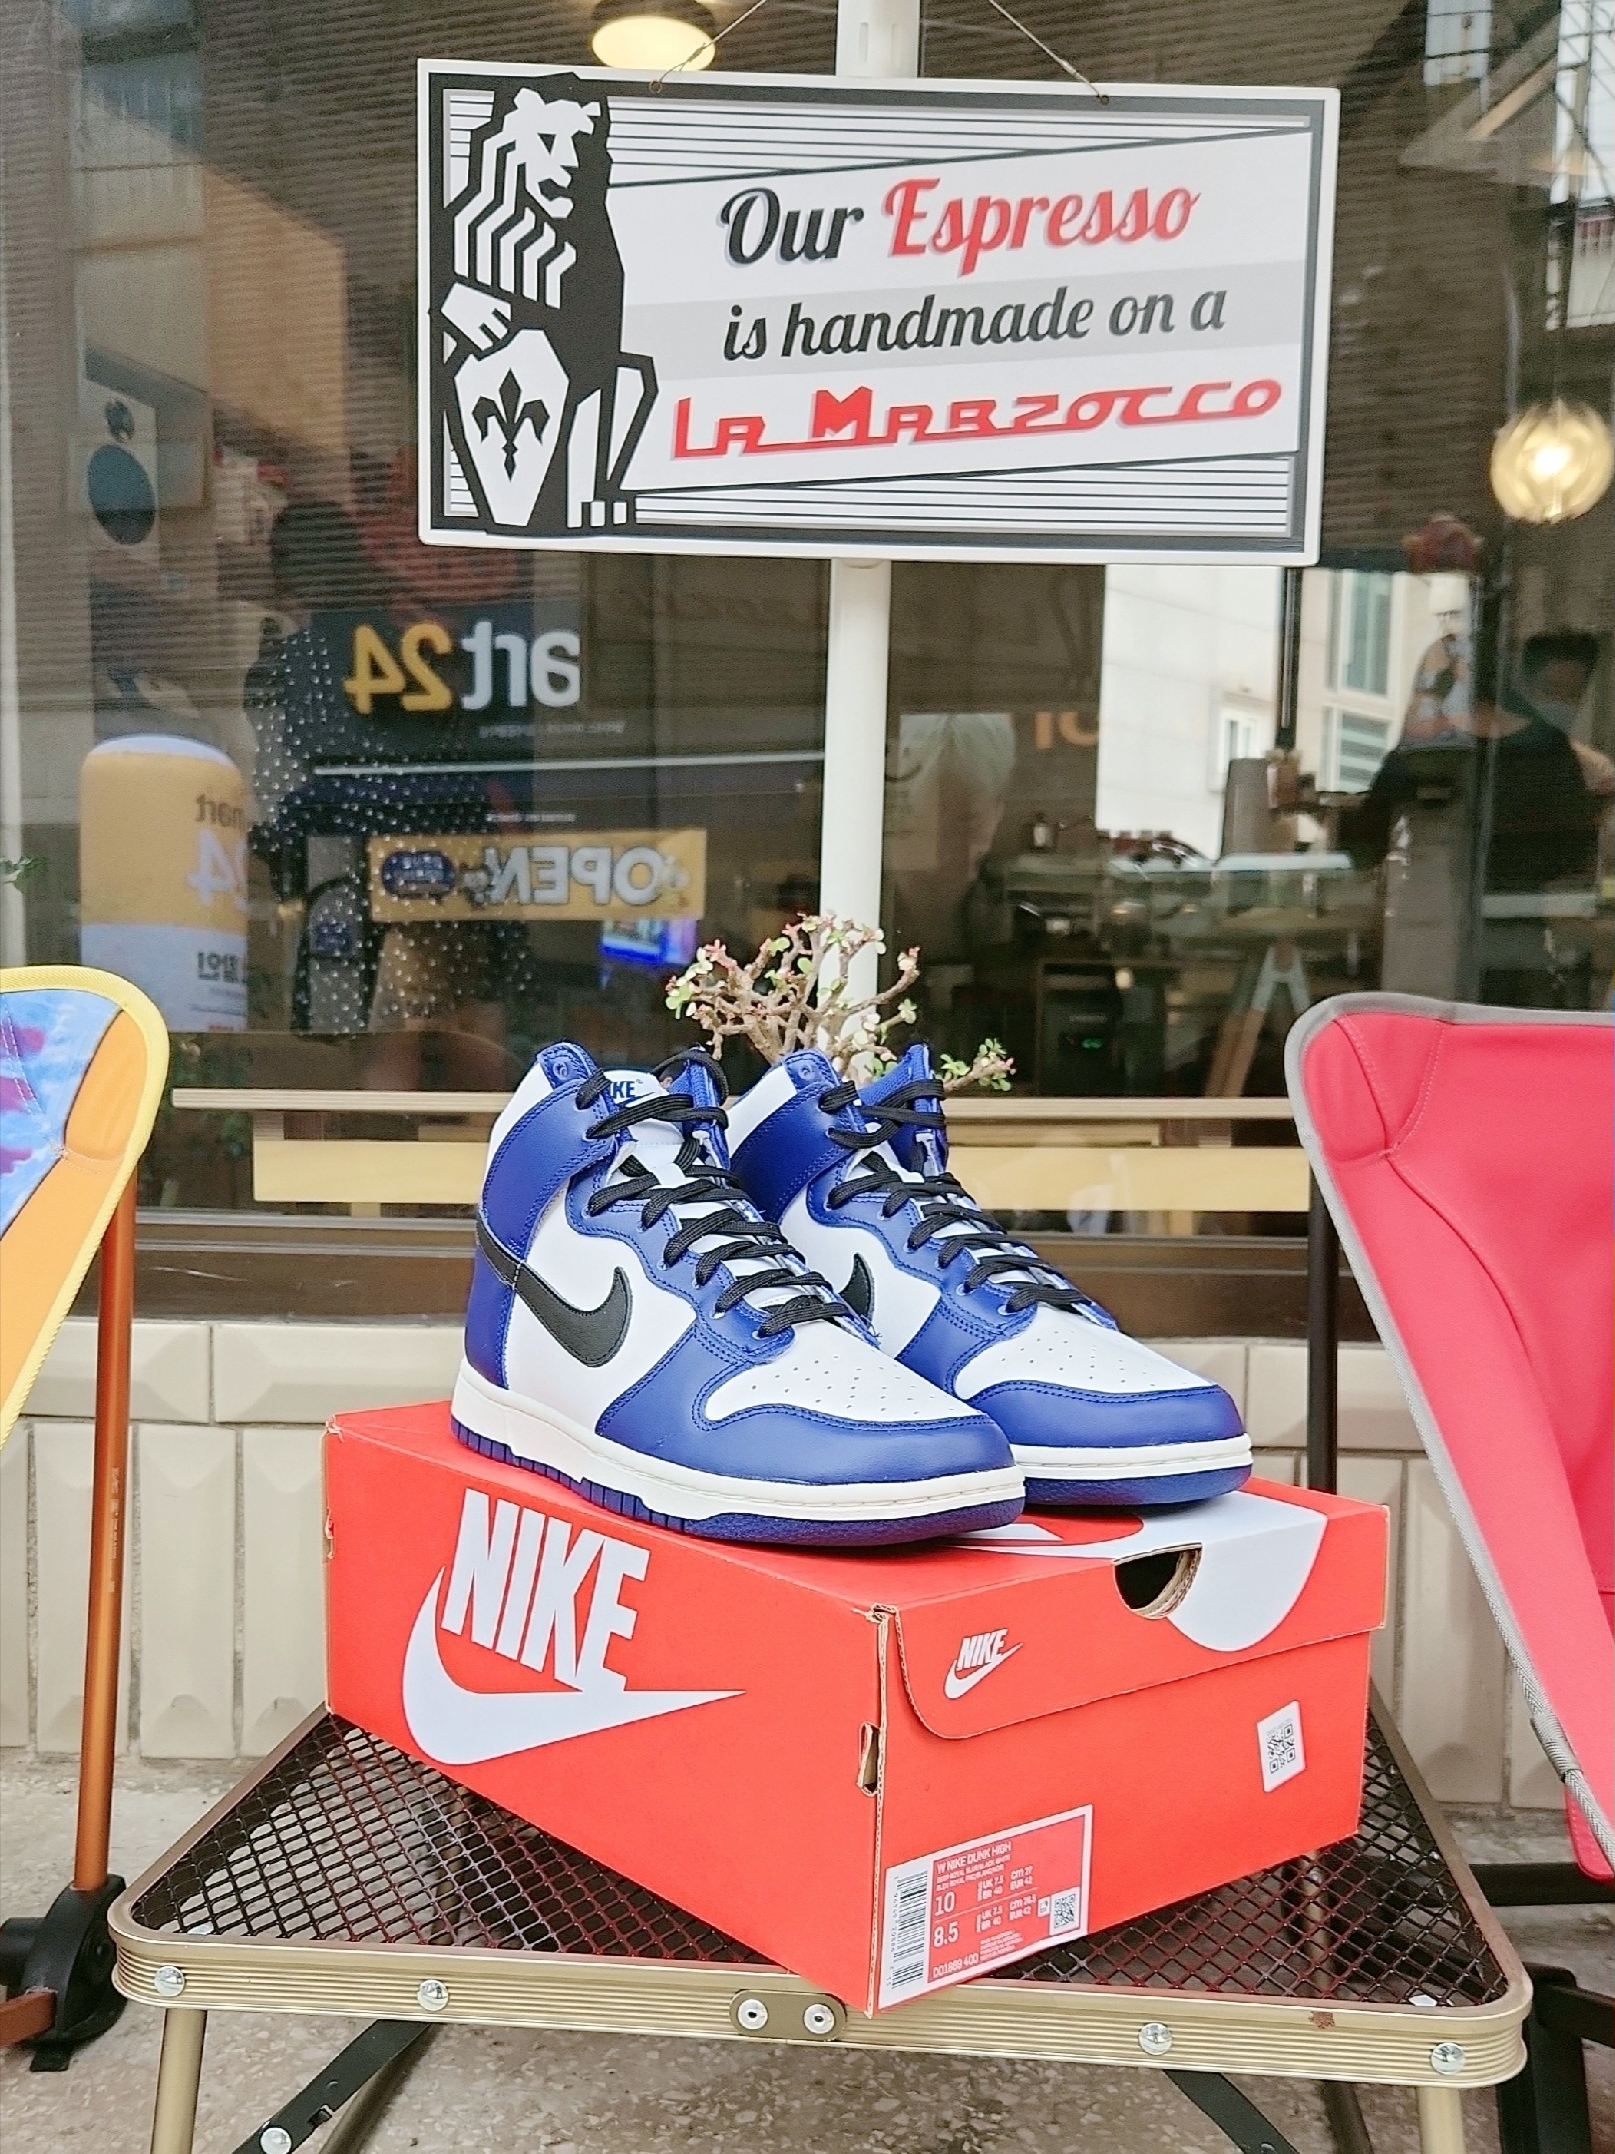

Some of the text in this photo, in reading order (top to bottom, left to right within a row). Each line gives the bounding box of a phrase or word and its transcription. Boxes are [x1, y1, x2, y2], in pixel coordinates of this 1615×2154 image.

[718, 178, 1202, 276] Our Espresso
[724, 286, 1227, 362] is handmade on a
[441, 1488, 650, 1692] NIKE
[956, 1628, 1008, 1671] NIKE
[947, 1856, 967, 1871] NIKE
[967, 1848, 990, 1865] DUNK
[992, 1841, 1012, 1856] HIGH
[935, 1891, 955, 1916] 10
[933, 1921, 959, 1947] 8.5
